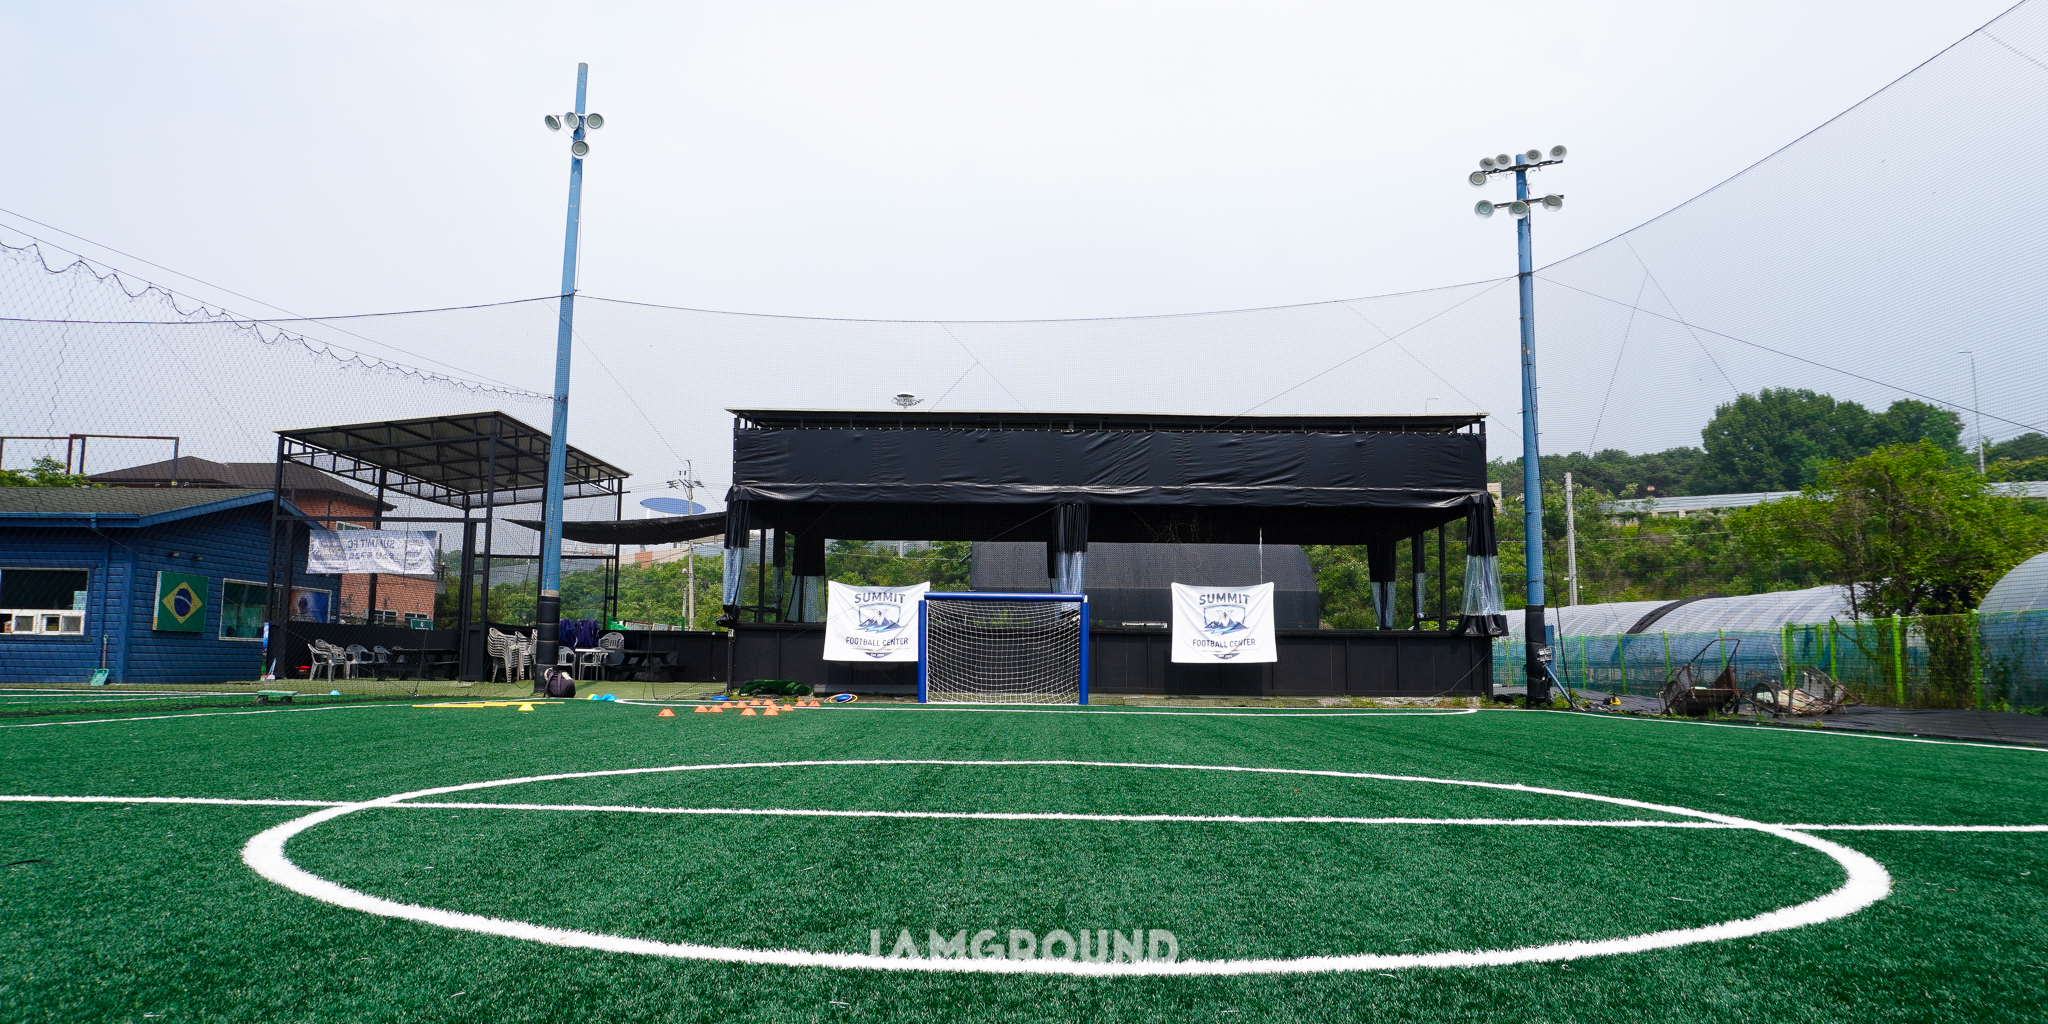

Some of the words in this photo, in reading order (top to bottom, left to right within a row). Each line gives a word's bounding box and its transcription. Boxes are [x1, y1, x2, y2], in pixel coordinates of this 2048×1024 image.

[855, 592, 906, 604] SUMMIT
[1199, 592, 1250, 605] SUMMIT
[845, 636, 881, 647] FOOTBALL
[882, 637, 909, 648] CENTER
[1192, 638, 1228, 648] FOOTBALL
[1229, 638, 1256, 648] CENTER
